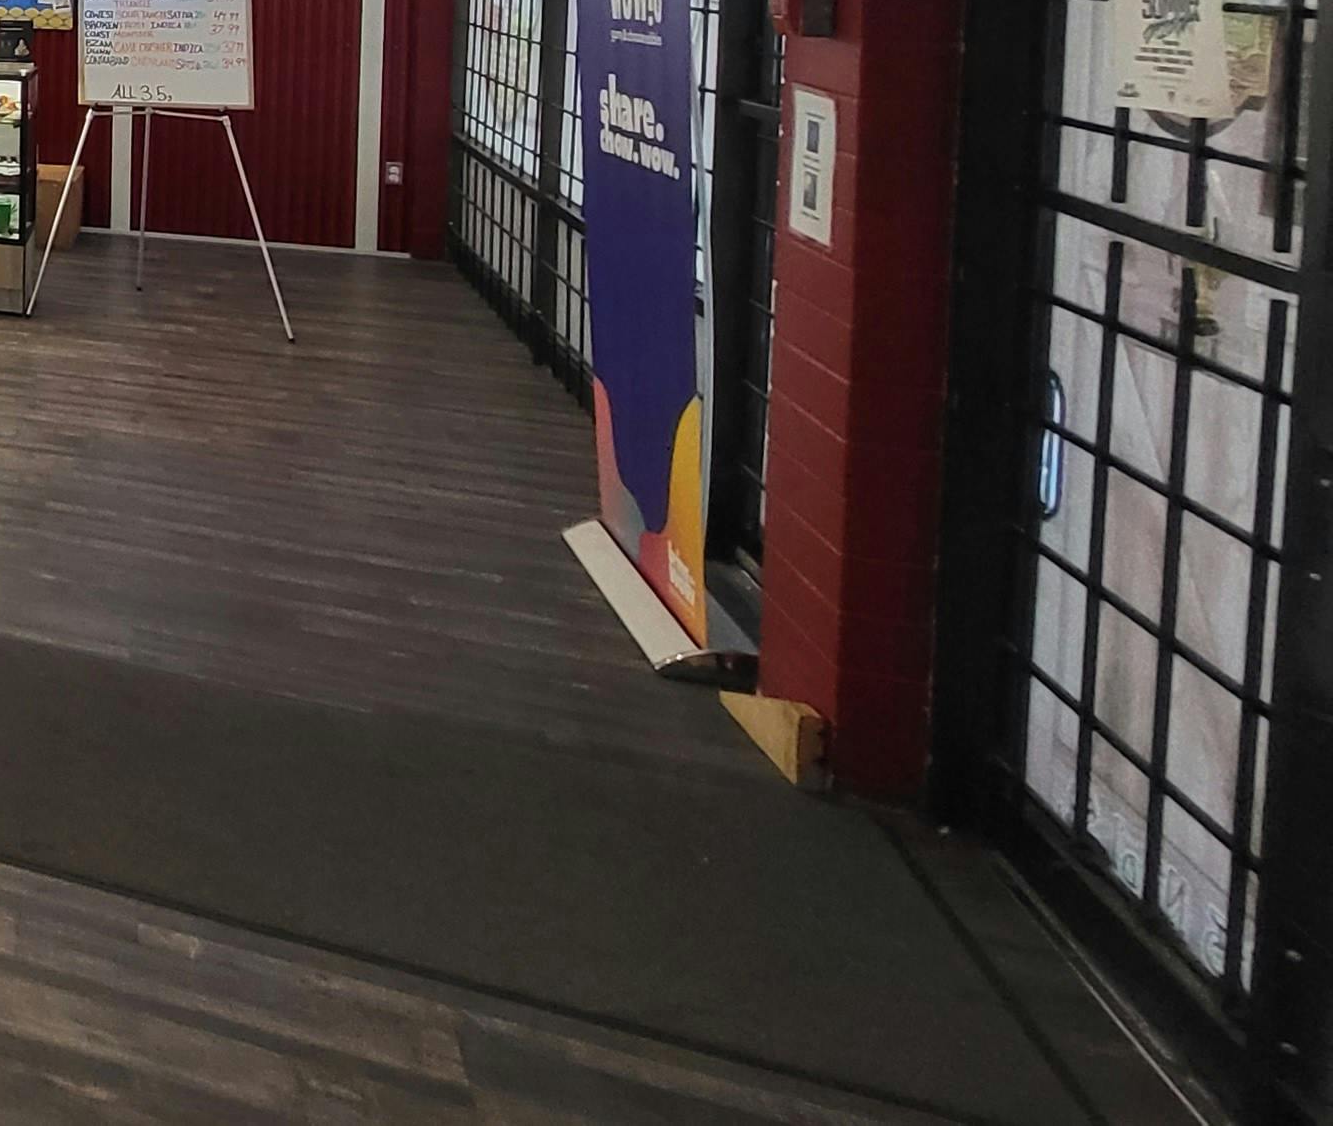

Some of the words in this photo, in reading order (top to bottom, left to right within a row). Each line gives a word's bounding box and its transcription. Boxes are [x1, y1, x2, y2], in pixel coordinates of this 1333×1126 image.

[173, 42, 205, 53] INDICA
[110, 83, 137, 100] ALL
[599, 73, 665, 142] share.
[639, 140, 680, 181] wow.
